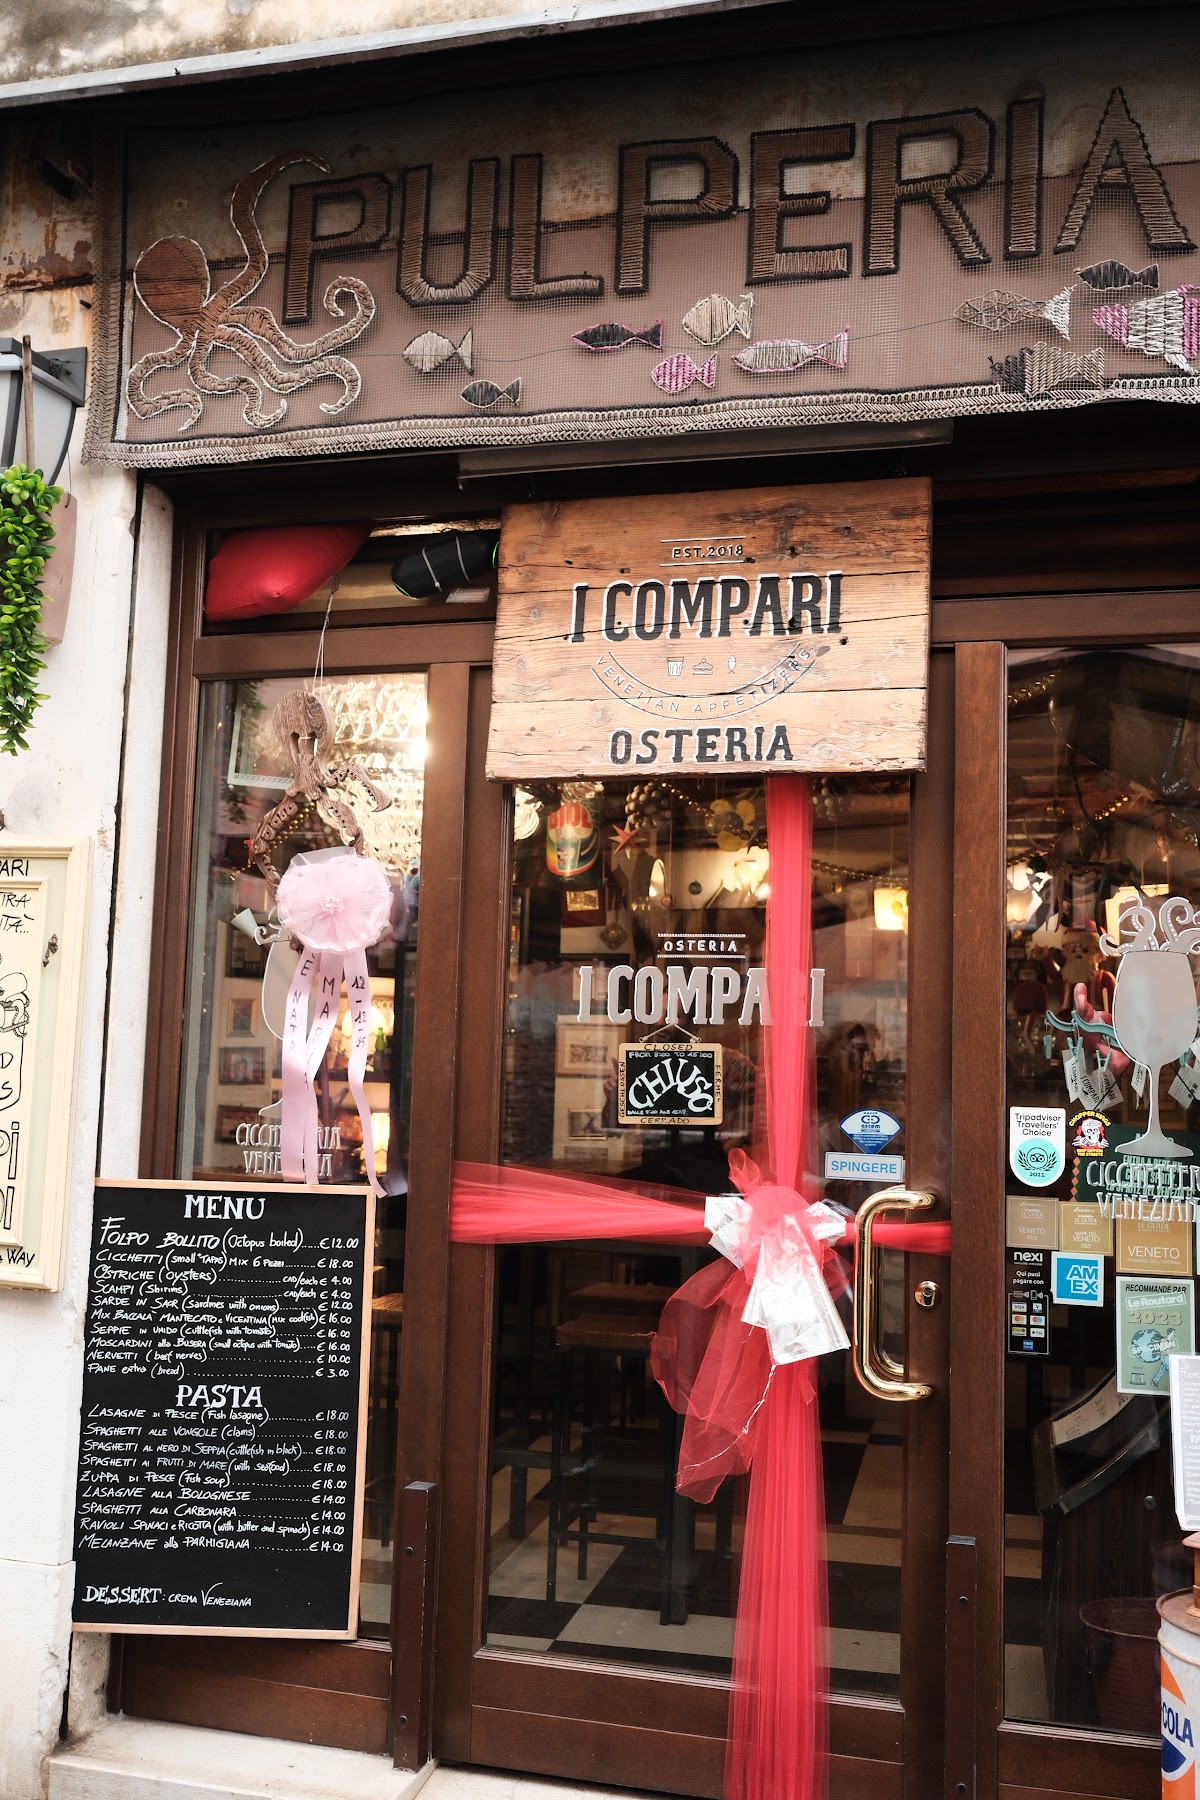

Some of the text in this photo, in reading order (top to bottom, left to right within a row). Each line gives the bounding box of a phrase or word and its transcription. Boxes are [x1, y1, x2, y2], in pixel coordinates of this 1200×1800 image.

[283, 86, 1195, 323] PULPERIA
[672, 543, 744, 558] EST.2018
[568, 570, 843, 643] I COMPARI
[597, 655, 680, 713] VENETIAN
[609, 724, 794, 765] OSTERIA
[664, 940, 737, 952] OSTERIA
[577, 966, 593, 1022] I
[629, 1058, 714, 1112] CHIUSO
[1015, 1113, 1061, 1121] Tripadvisor
[1017, 1121, 1059, 1129] Travellers'
[1069, 1111, 1095, 1126] CHOPPER
[831, 1160, 897, 1174] SPINGERE
[184, 1194, 266, 1220] MENU
[100, 1217, 149, 1245] FOLPO
[156, 1232, 220, 1249] BOLLITO
[223, 1227, 265, 1253] (Octopus
[269, 1227, 304, 1253] boiled)
[7, 1247, 35, 1267] WAY
[96, 1249, 262, 1271] CICCHETTI (small MIX 6
[1013, 1251, 1043, 1262] nexi
[1127, 1245, 1180, 1259] VENETO
[94, 1264, 155, 1280] OSTRICHE
[1066, 1265, 1098, 1280] AM
[91, 1280, 134, 1295] SCAMPI
[1125, 1284, 1171, 1293] RECOMMANDÉ
[91, 1296, 131, 1306] SARDE
[136, 1298, 148, 1306] IN
[150, 1297, 179, 1309] SAOR
[228, 1298, 247, 1309] with
[159, 1313, 217, 1323] MANTECATO
[225, 1312, 267, 1325] VICENTINA
[1128, 1310, 1182, 1326] 2023
[90, 1322, 132, 1335] SEPPIE
[152, 1326, 178, 1334] UMIDO
[226, 1326, 242, 1335] with
[87, 1337, 152, 1348] MOSCARDINI
[157, 1338, 171, 1348] alla
[173, 1338, 207, 1348] BUSERA
[208, 1337, 231, 1351] (small
[232, 1339, 256, 1352] octopus
[257, 1339, 272, 1349] with
[86, 1349, 138, 1360] NERVETTI
[87, 1363, 116, 1373] PANE
[150, 1361, 184, 1381] (bread)
[175, 1384, 263, 1408] PASTA
[88, 1403, 146, 1418] LASAGNE
[165, 1408, 199, 1419] PESCE
[201, 1406, 226, 1424] (Fish
[230, 1407, 269, 1427] lasagne)
[83, 1422, 256, 1441] SPAGHETTI ALLE VONGOLE (clams)
[82, 1439, 138, 1452] SPAGHETTI
[142, 1444, 153, 1452] AL
[156, 1444, 179, 1452] NERO
[181, 1445, 191, 1453] DI
[191, 1442, 226, 1455] SEPPIA
[79, 1453, 137, 1467] SPAGHETTI
[156, 1457, 185, 1466] FRUTTI
[199, 1460, 228, 1470] MARE
[228, 1458, 250, 1476] (with
[79, 1470, 120, 1483] ZUPPA
[144, 1471, 176, 1482] PESCE
[178, 1469, 201, 1487] (Fish
[202, 1472, 230, 1488] soup)
[82, 1485, 251, 1501] LASAGNE ALLA BOLOGNESE
[78, 1501, 237, 1517] SPAGHETTI ALLA CARBONARA
[79, 1517, 124, 1530] RAVIOLI
[129, 1519, 168, 1531] SPINACI
[178, 1519, 211, 1532] RICOTTA
[213, 1516, 234, 1536] (with
[236, 1520, 259, 1532] butter
[261, 1520, 276, 1533] and
[276, 1520, 311, 1541] spinach)
[78, 1533, 250, 1550] MELANZANE alla PARMIGIANA
[168, 1593, 198, 1603] CREMA
[200, 1582, 252, 1607] VENEZIANA
[1163, 1702, 1194, 1747] COLA
